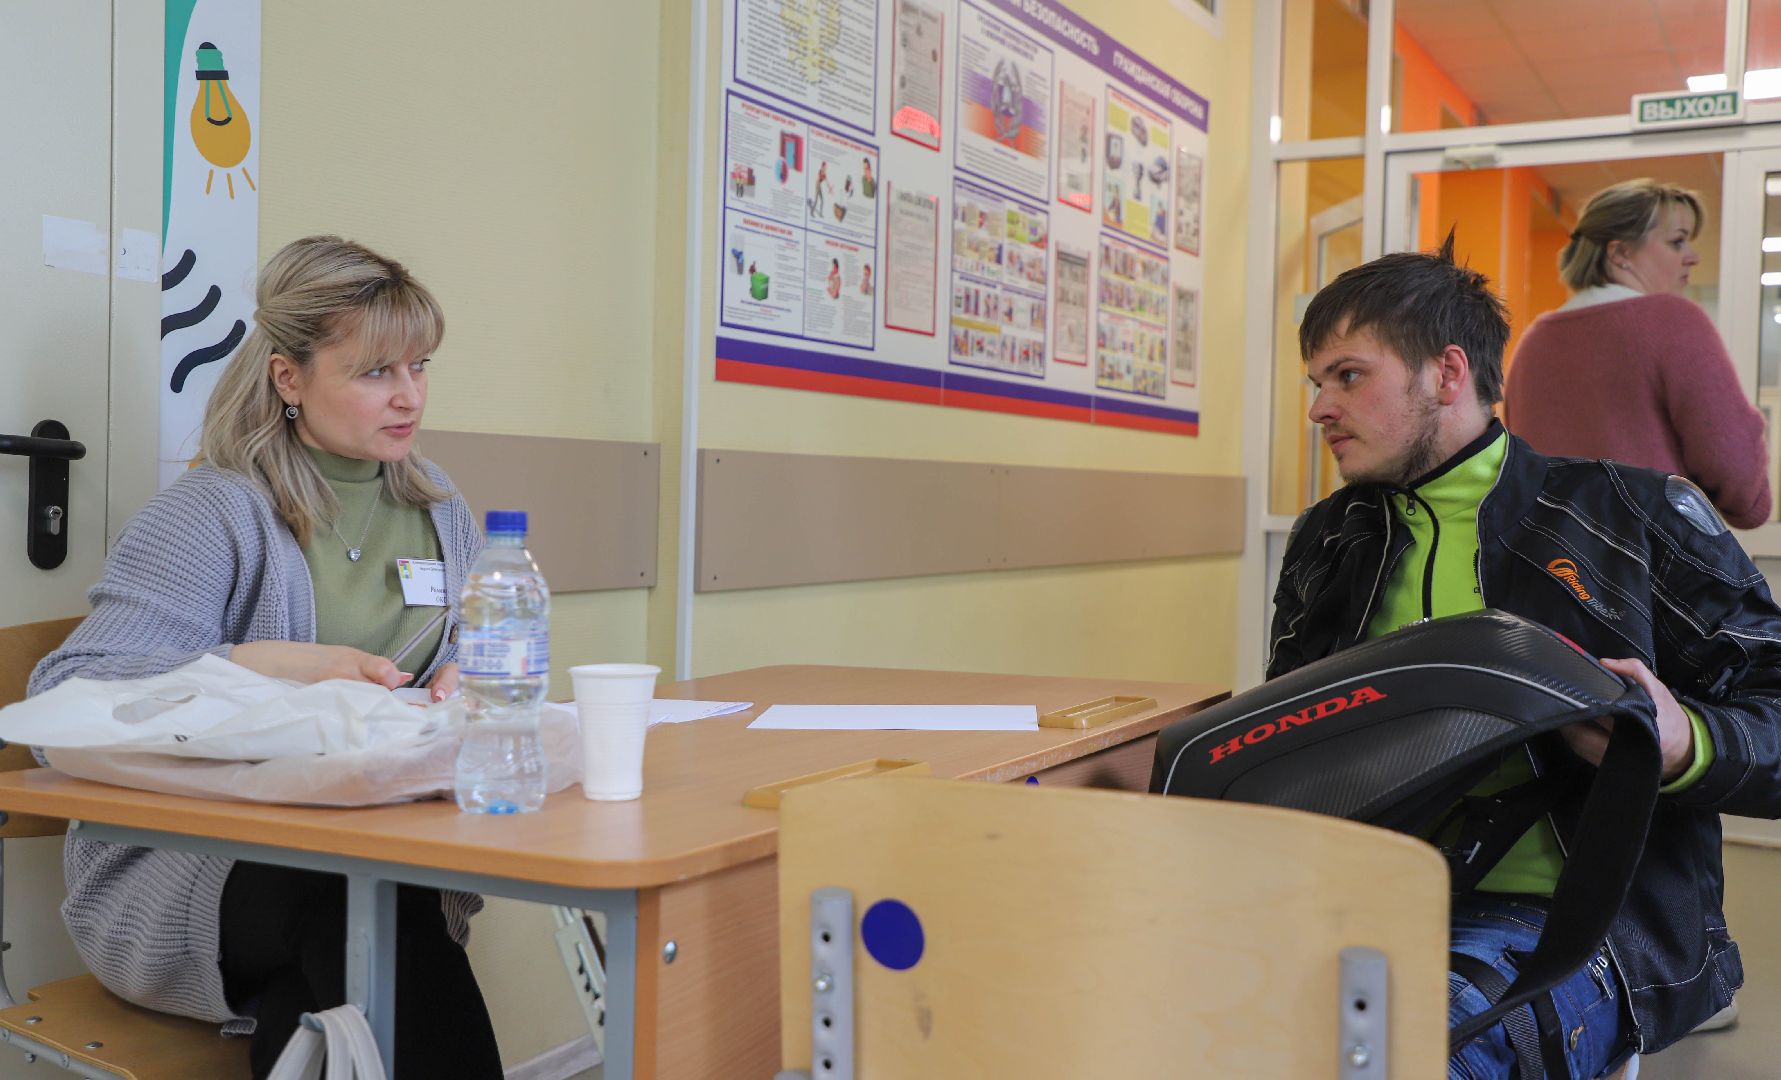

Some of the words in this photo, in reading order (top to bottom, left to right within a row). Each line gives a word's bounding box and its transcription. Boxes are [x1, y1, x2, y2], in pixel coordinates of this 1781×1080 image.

[1643, 95, 1732, 120] ВЫХОД
[1566, 574, 1590, 600] Riding
[1209, 686, 1387, 765] HONDA
